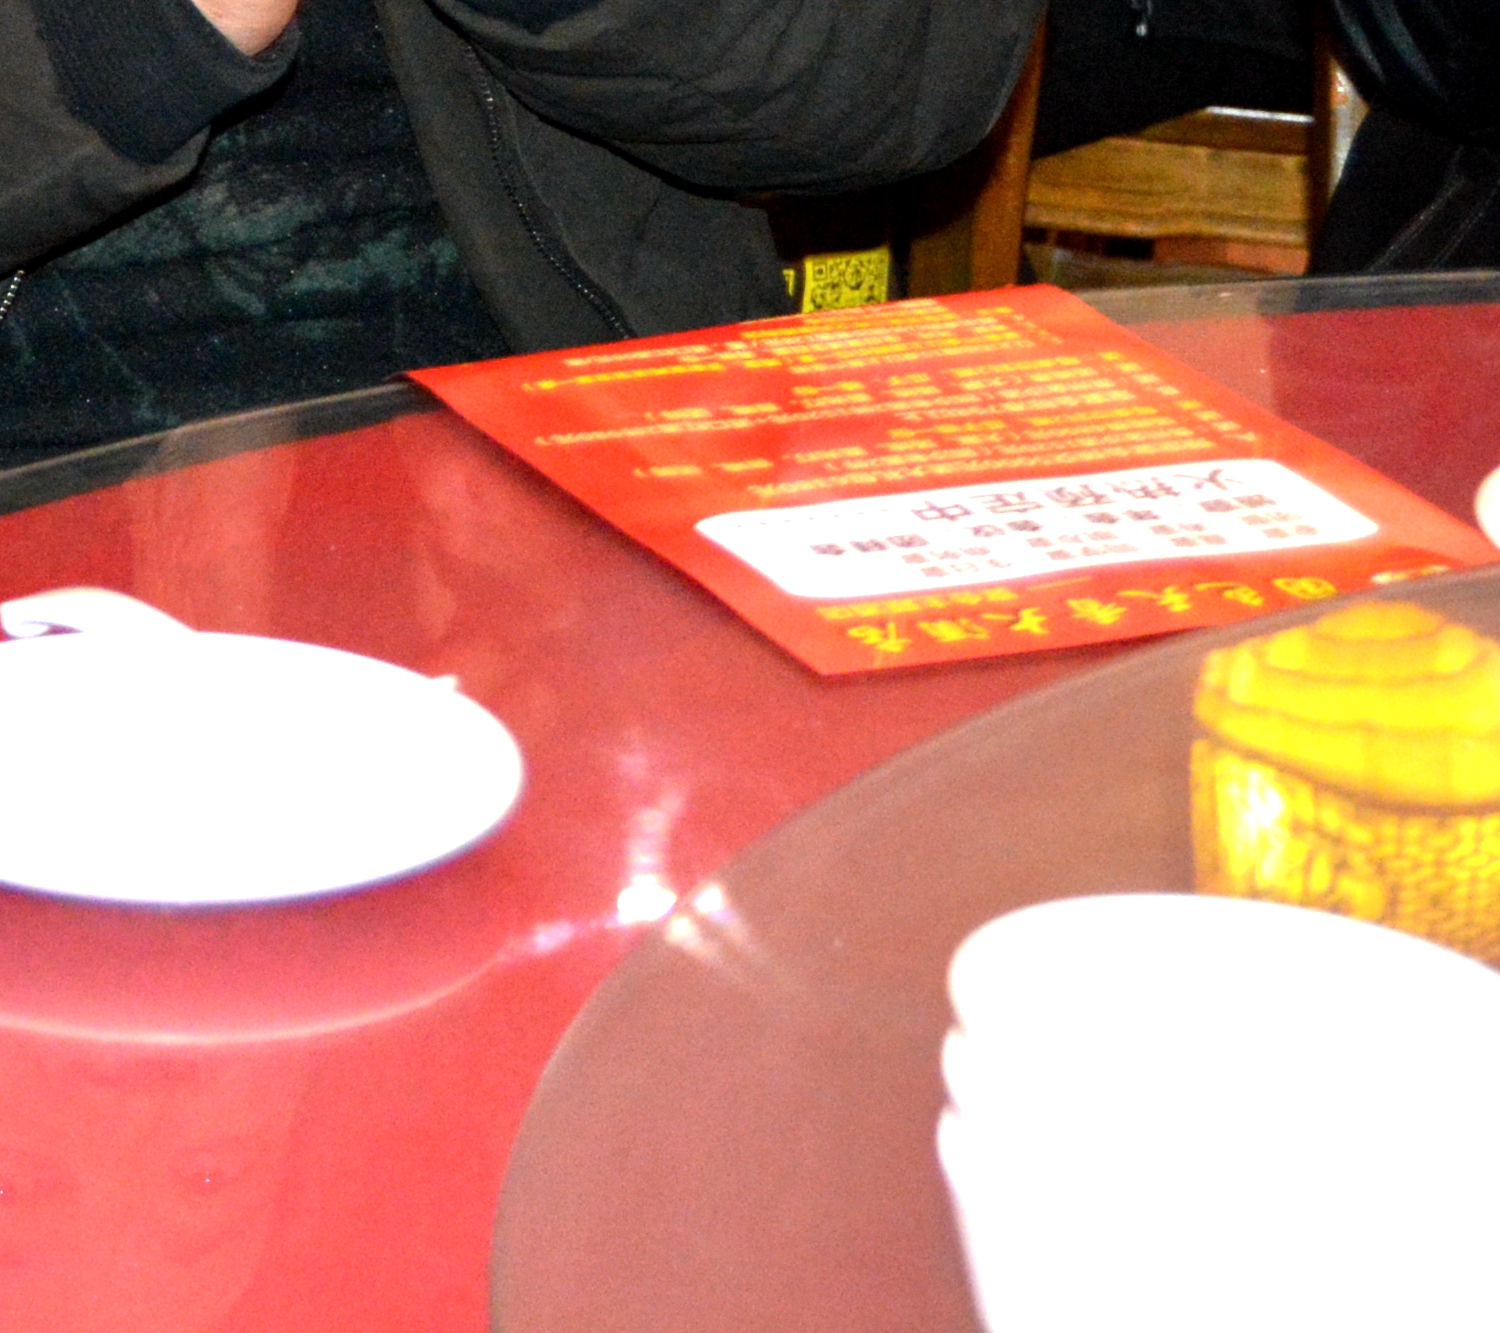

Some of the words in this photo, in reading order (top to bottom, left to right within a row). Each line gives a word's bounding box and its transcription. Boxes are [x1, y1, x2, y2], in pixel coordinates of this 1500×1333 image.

[848, 573, 1338, 658] 国色天香大酒店
